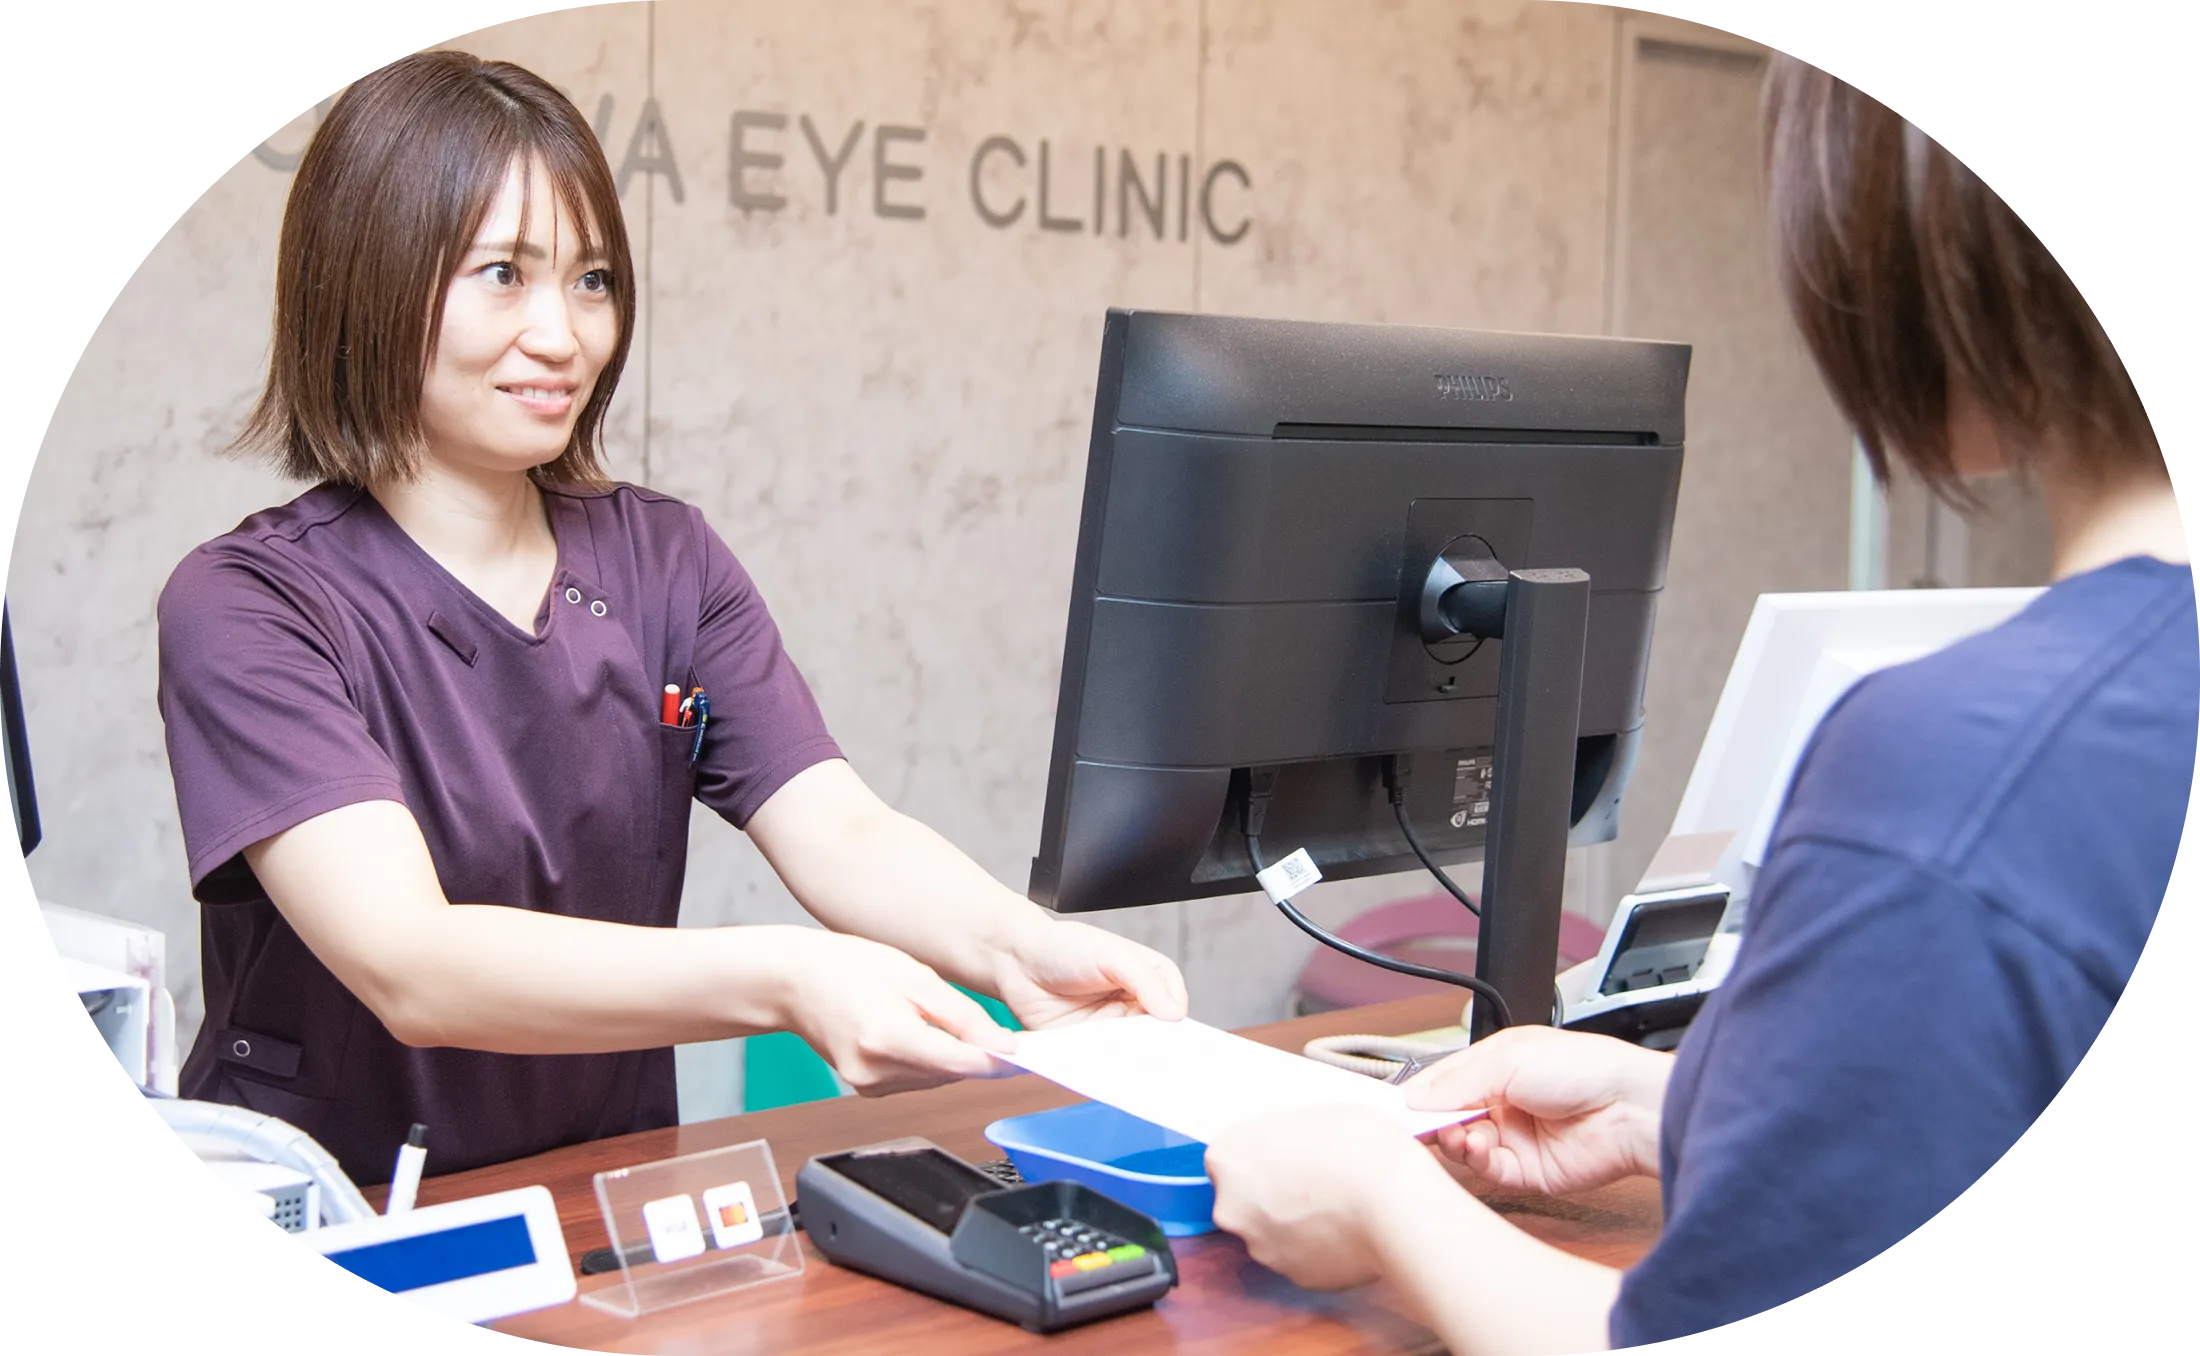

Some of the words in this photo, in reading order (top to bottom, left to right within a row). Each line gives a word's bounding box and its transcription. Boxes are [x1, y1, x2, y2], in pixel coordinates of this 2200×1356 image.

[728, 110, 927, 220] EYE
[969, 135, 1252, 246] CLINIC
[1434, 373, 1513, 402] PHILIPS
